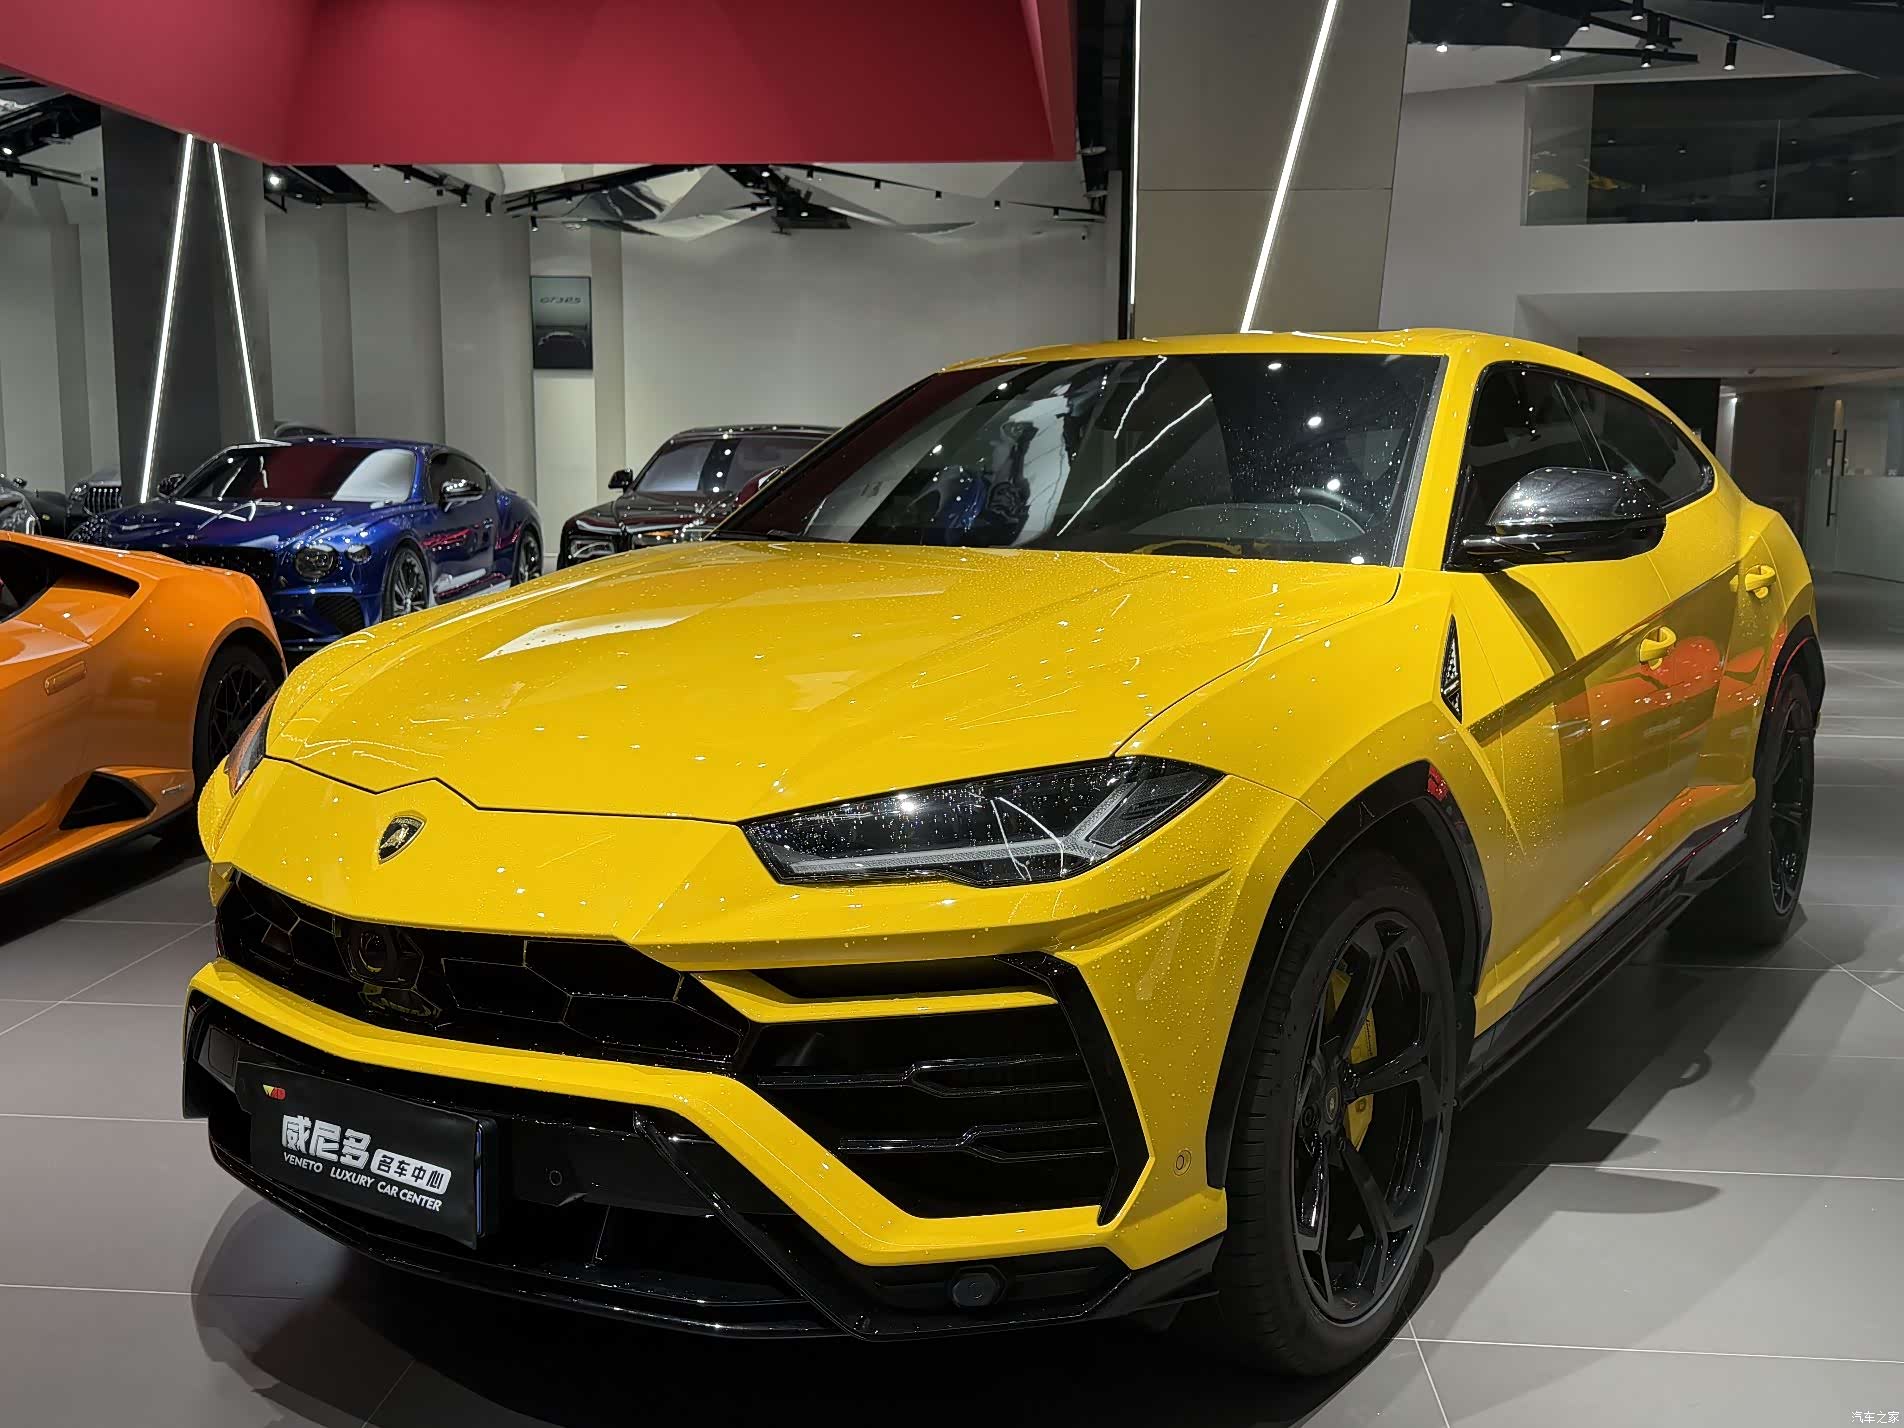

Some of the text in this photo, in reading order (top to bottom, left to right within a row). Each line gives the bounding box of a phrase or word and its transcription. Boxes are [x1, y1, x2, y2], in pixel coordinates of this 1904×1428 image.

[281, 1114, 444, 1190] 威尼多 名车中心
[283, 1151, 442, 1212] VENETO LUXURY CAR CENTER
